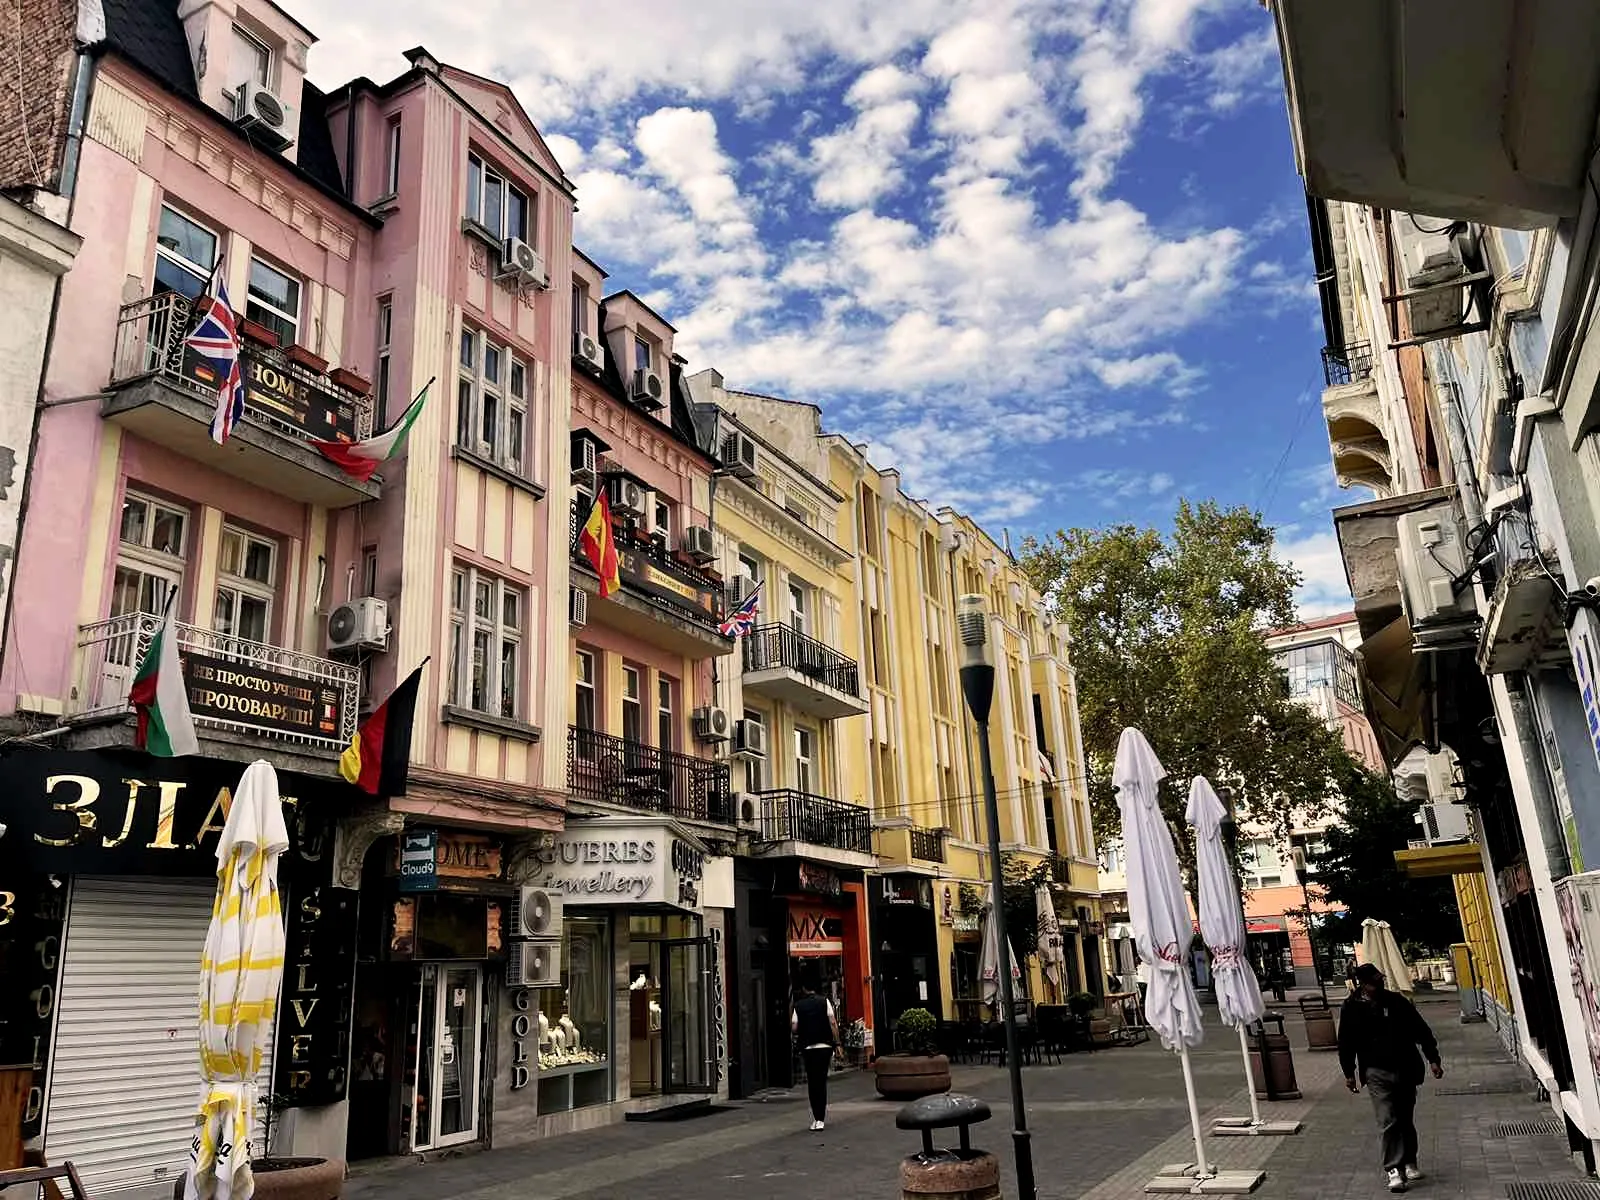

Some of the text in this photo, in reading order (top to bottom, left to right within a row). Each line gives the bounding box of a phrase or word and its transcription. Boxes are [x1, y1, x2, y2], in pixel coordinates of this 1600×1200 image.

[215, 669, 271, 692] ПРОСТО
[401, 863, 434, 876] Cloud9
[26, 935, 57, 1122] GOLD
[288, 895, 321, 1090] SILVER
[514, 989, 530, 1090] GOLD
